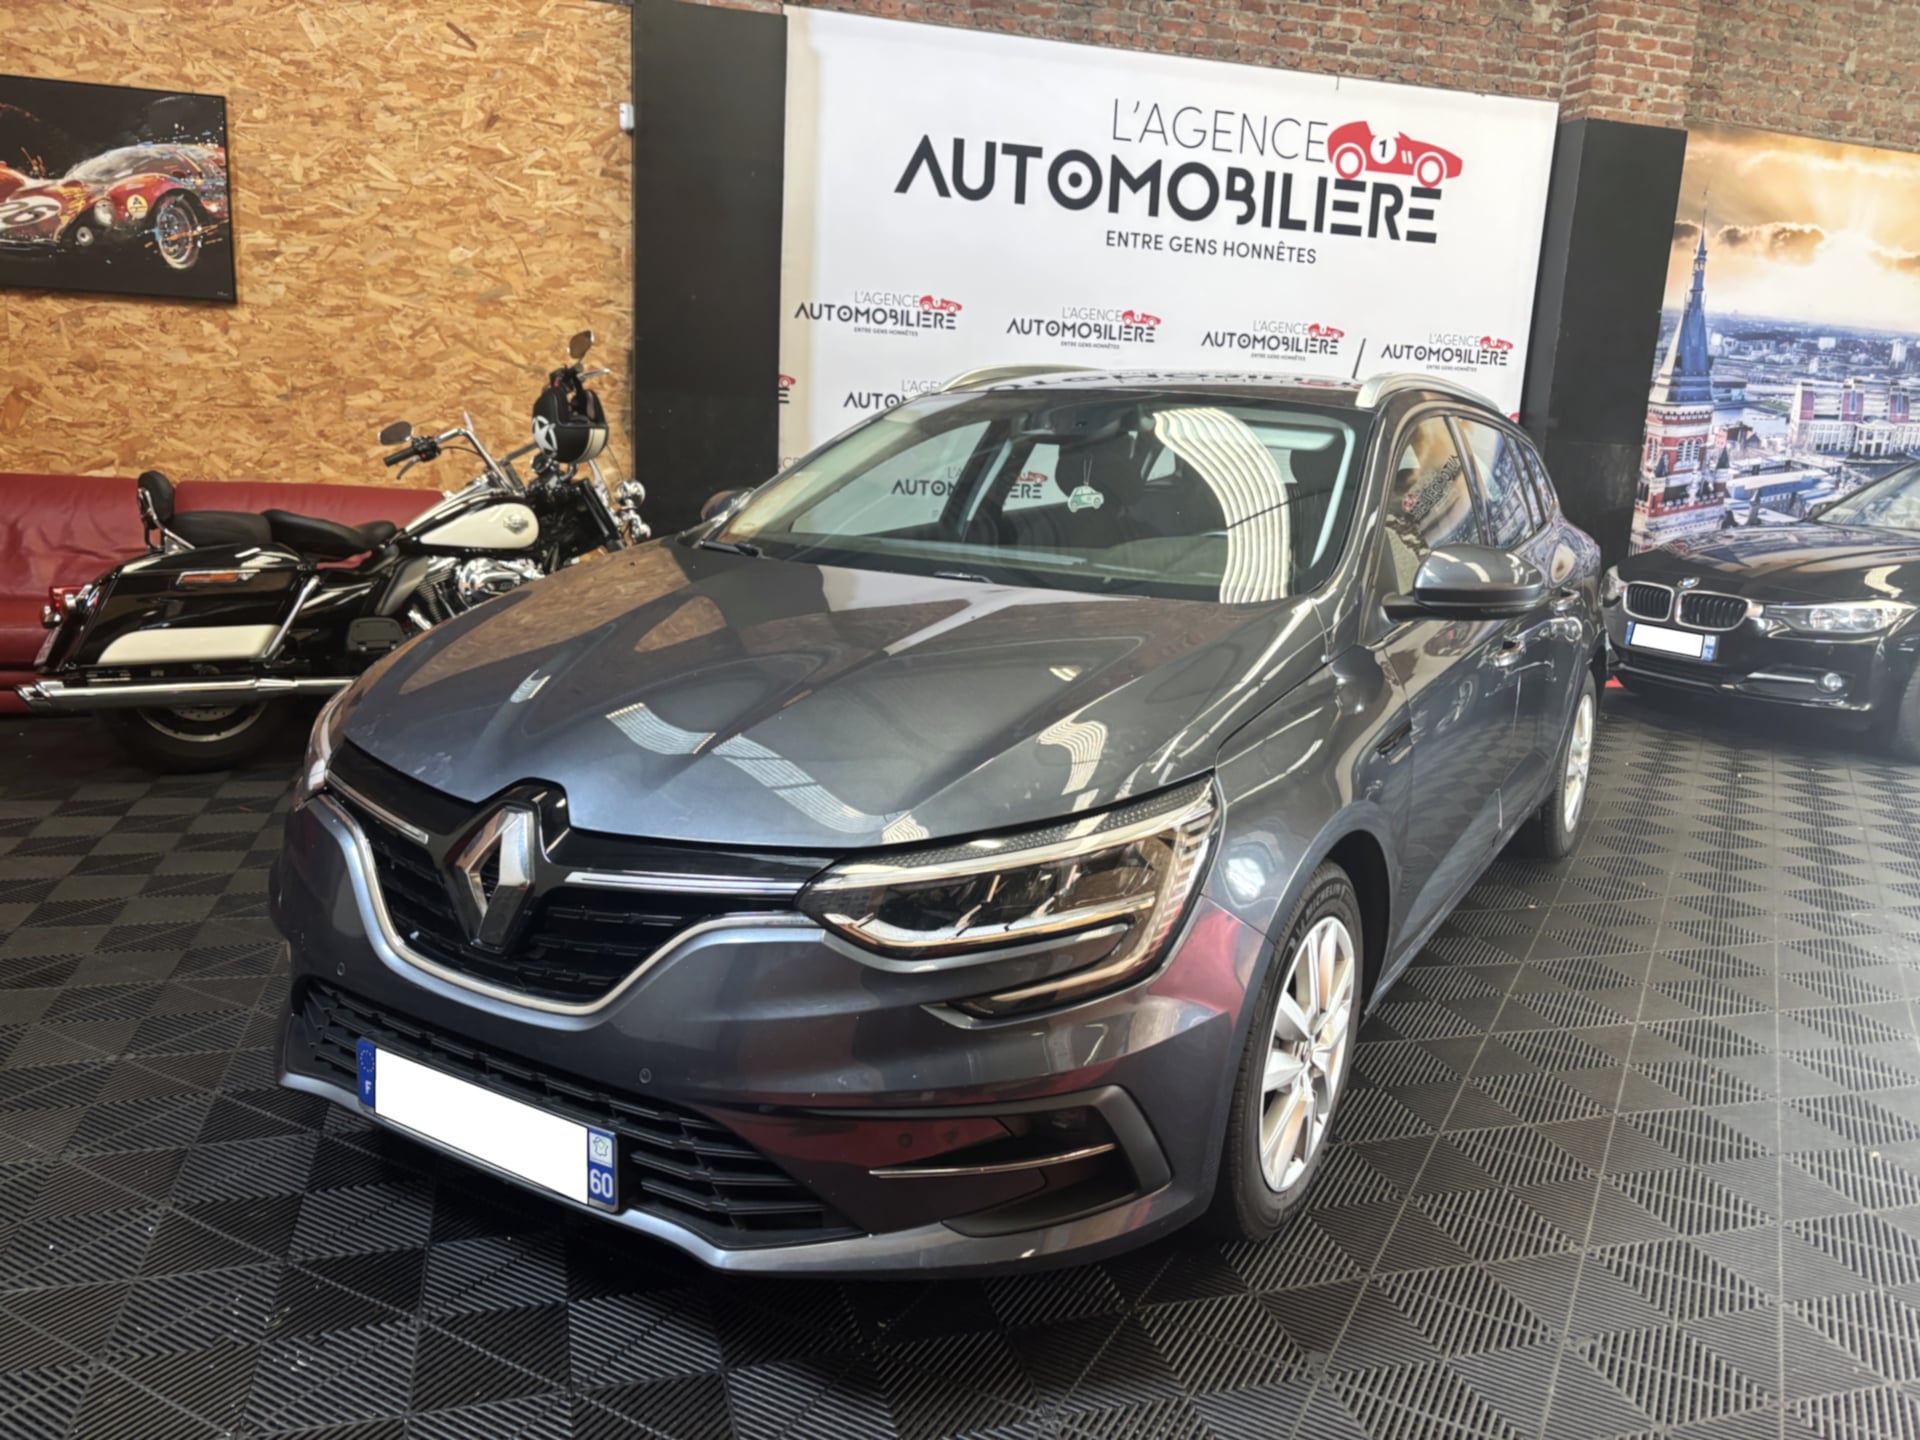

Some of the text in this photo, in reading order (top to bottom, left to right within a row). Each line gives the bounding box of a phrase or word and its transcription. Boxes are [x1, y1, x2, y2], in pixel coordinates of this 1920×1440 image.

[1112, 97, 1327, 164] L'AGENCE
[1377, 139, 1388, 158] 1
[1106, 230, 1317, 265] ENTRE GENS HONNÊTES
[854, 290, 920, 309] L'AGENCE
[1062, 306, 1122, 323] L'AGENCE
[365, 1080, 372, 1095] F
[590, 1168, 613, 1199] 60
